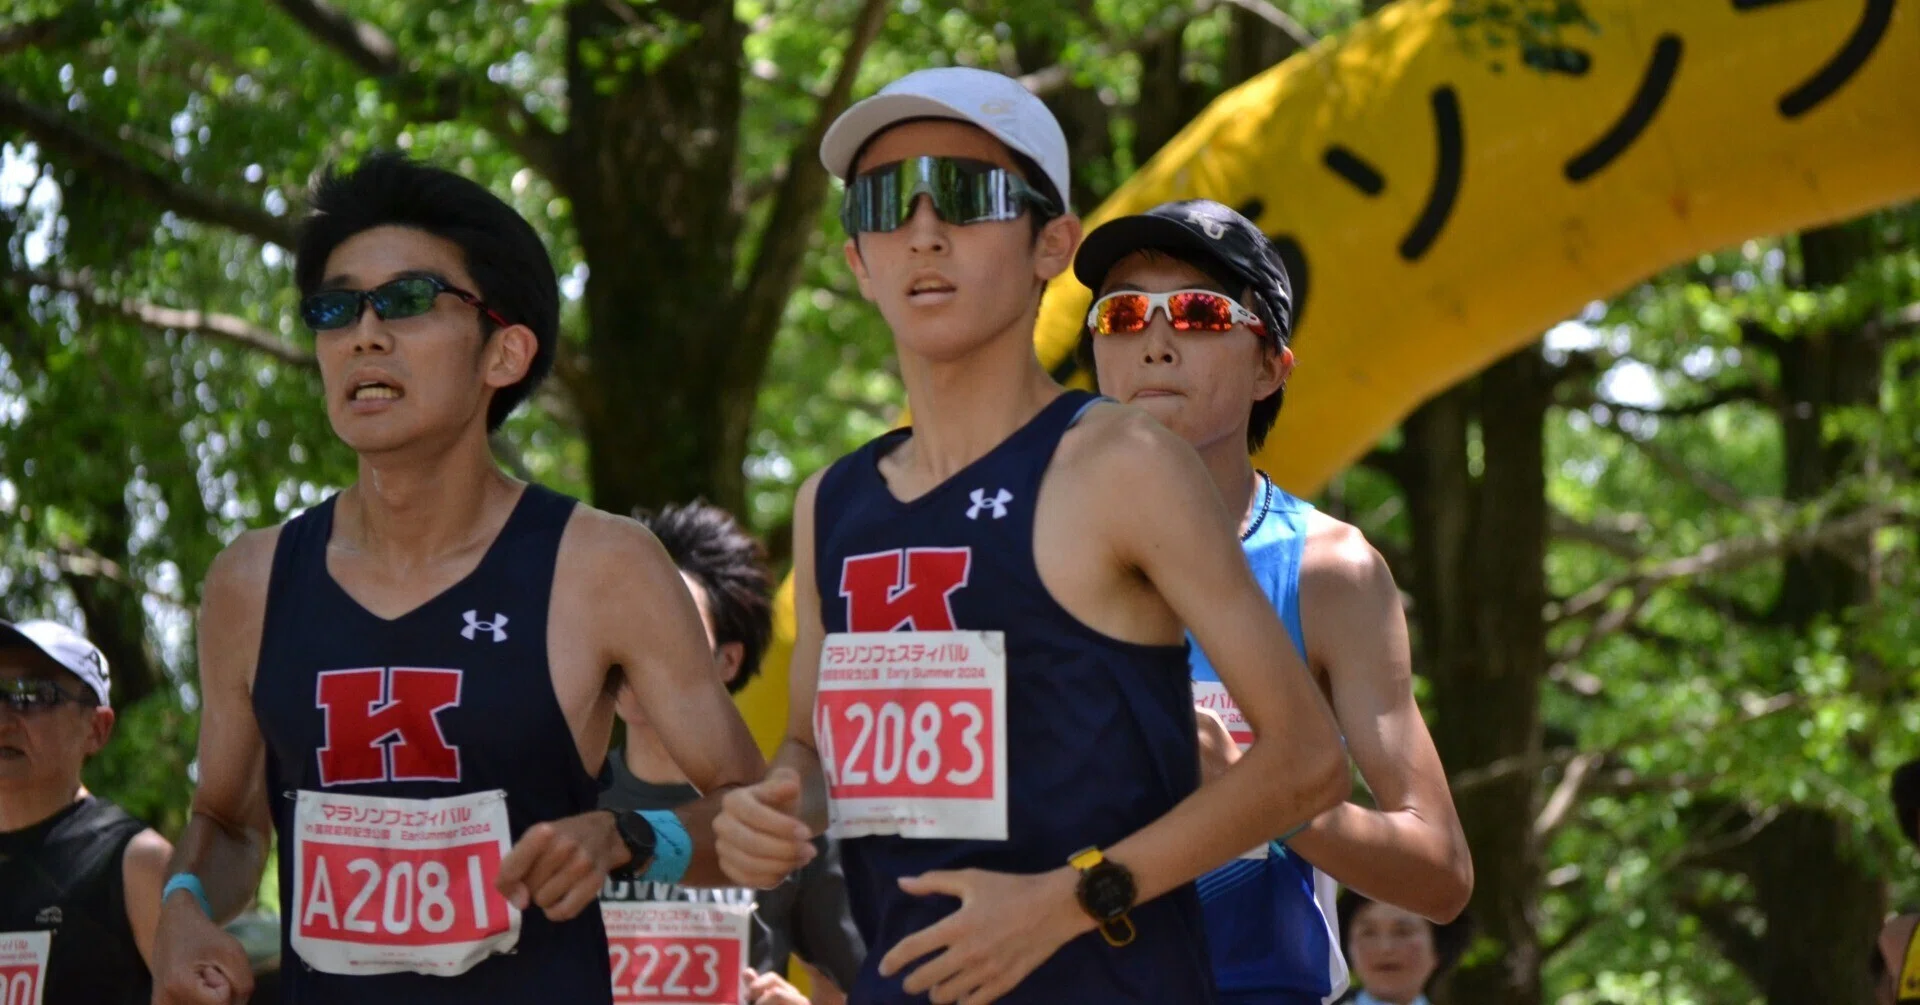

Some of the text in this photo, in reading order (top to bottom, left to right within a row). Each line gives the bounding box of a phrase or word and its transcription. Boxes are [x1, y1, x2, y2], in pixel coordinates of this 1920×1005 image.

[838, 546, 971, 633] K
[316, 666, 463, 787] K
[819, 701, 985, 786] A2083
[460, 823, 491, 837] 2024
[303, 855, 490, 935] A2081
